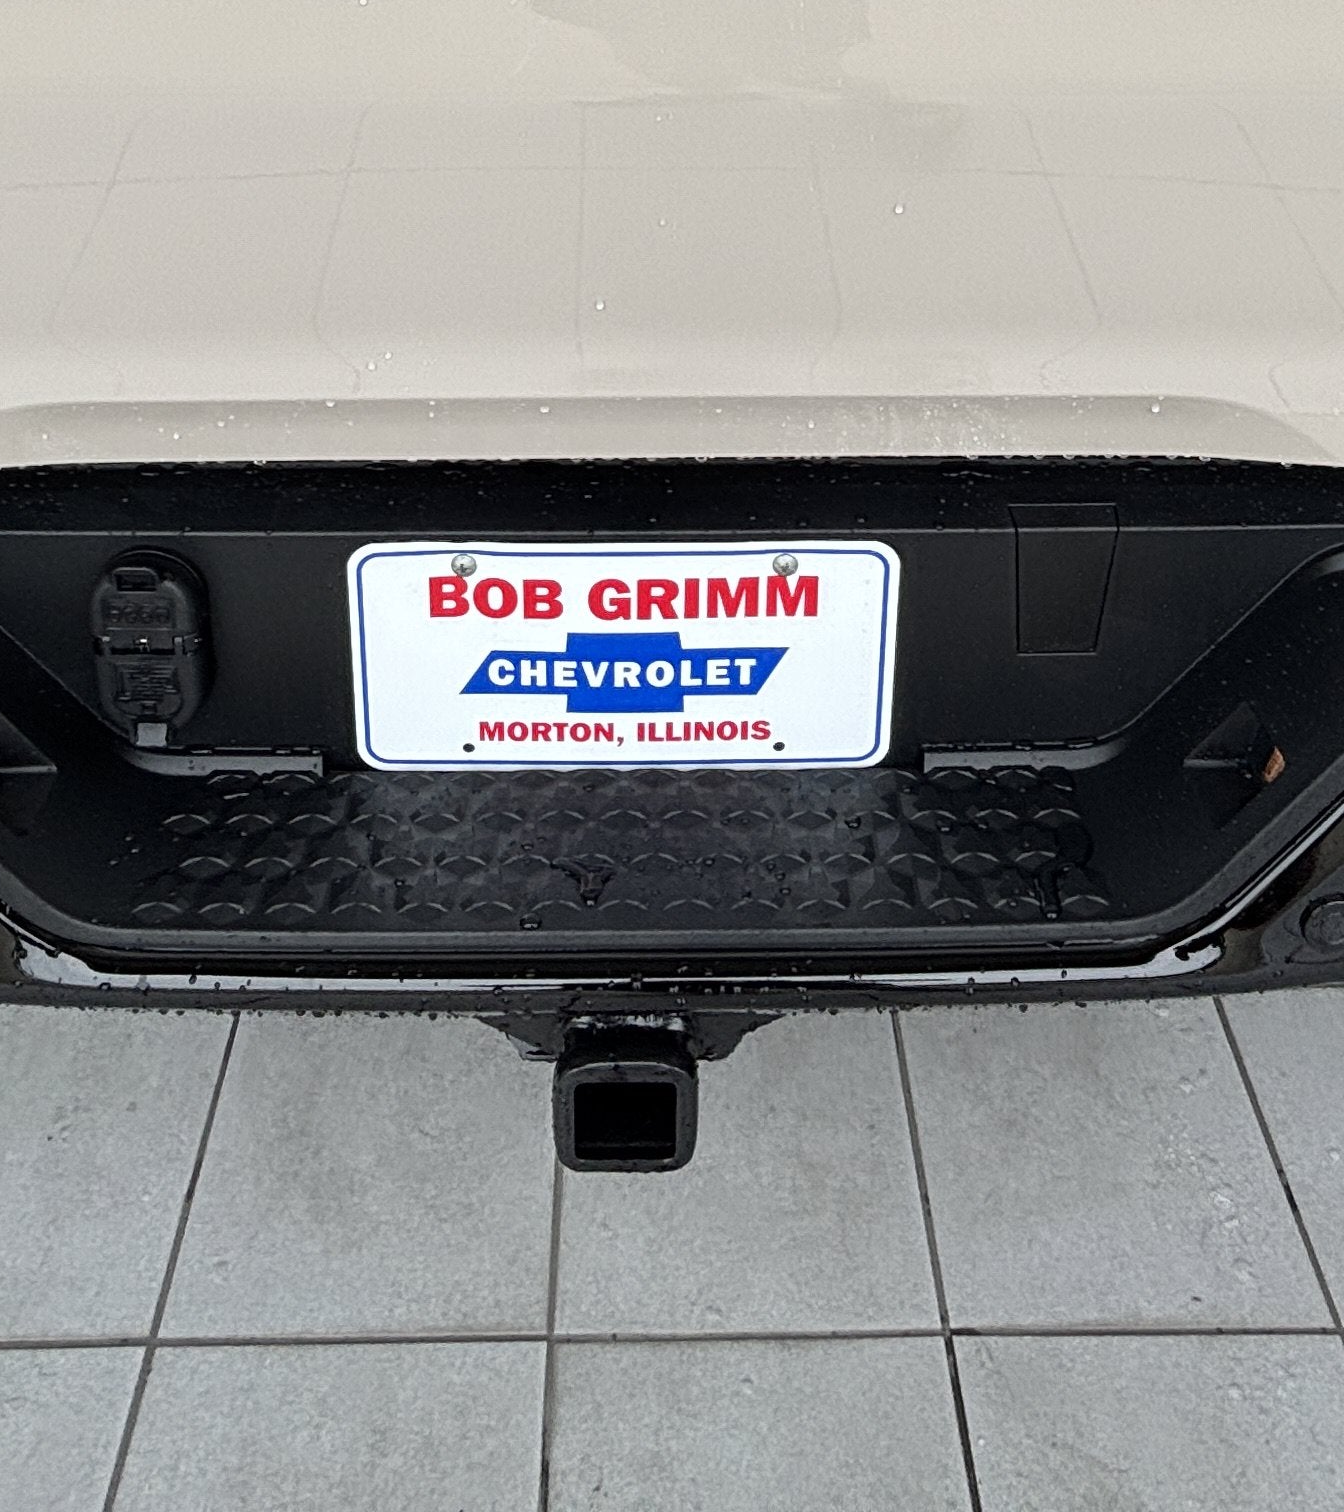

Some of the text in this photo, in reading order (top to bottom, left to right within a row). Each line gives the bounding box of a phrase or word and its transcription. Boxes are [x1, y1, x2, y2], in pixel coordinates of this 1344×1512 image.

[429, 575, 819, 620] BOB GRIMM
[487, 657, 758, 688] CHEVROLET
[478, 719, 772, 747] MORTON, ILLINOIS
